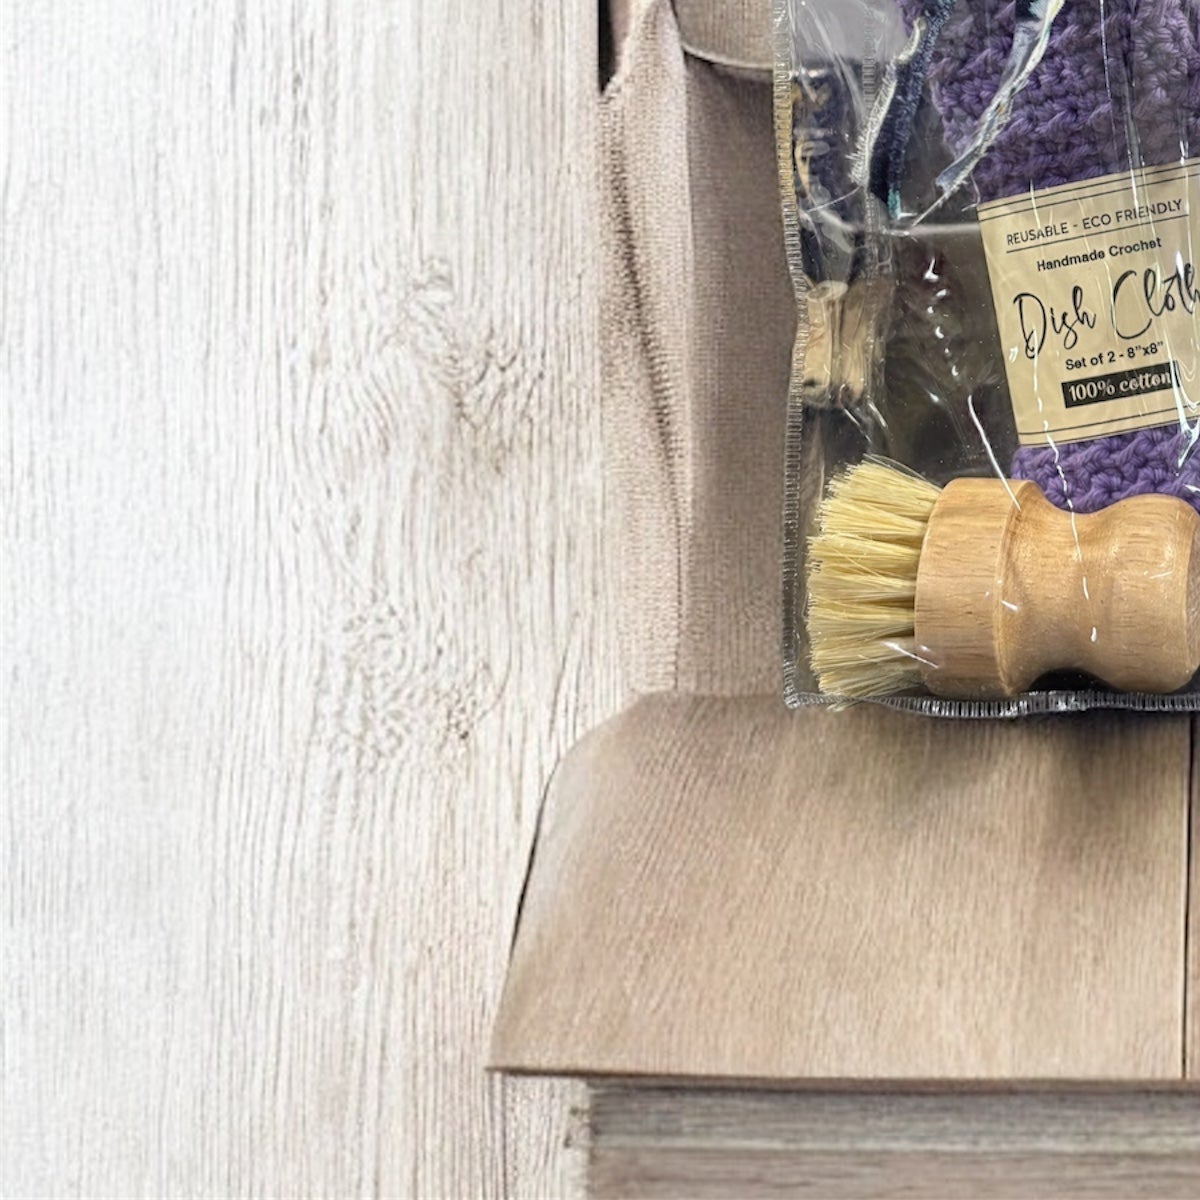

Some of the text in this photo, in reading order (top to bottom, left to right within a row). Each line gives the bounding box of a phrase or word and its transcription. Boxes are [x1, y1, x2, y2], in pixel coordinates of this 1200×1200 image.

[1006, 221, 1070, 247] REUSABLE
[1082, 212, 1112, 230] ECO
[1115, 199, 1183, 223] FRIENDLY
[1036, 236, 1163, 273] Handmade Crochet
[1012, 285, 1097, 360] Dish
[1065, 357, 1087, 371] Set
[1089, 352, 1104, 365] of
[1107, 350, 1116, 363] 2
[1068, 368, 1172, 402] 100% cotton
